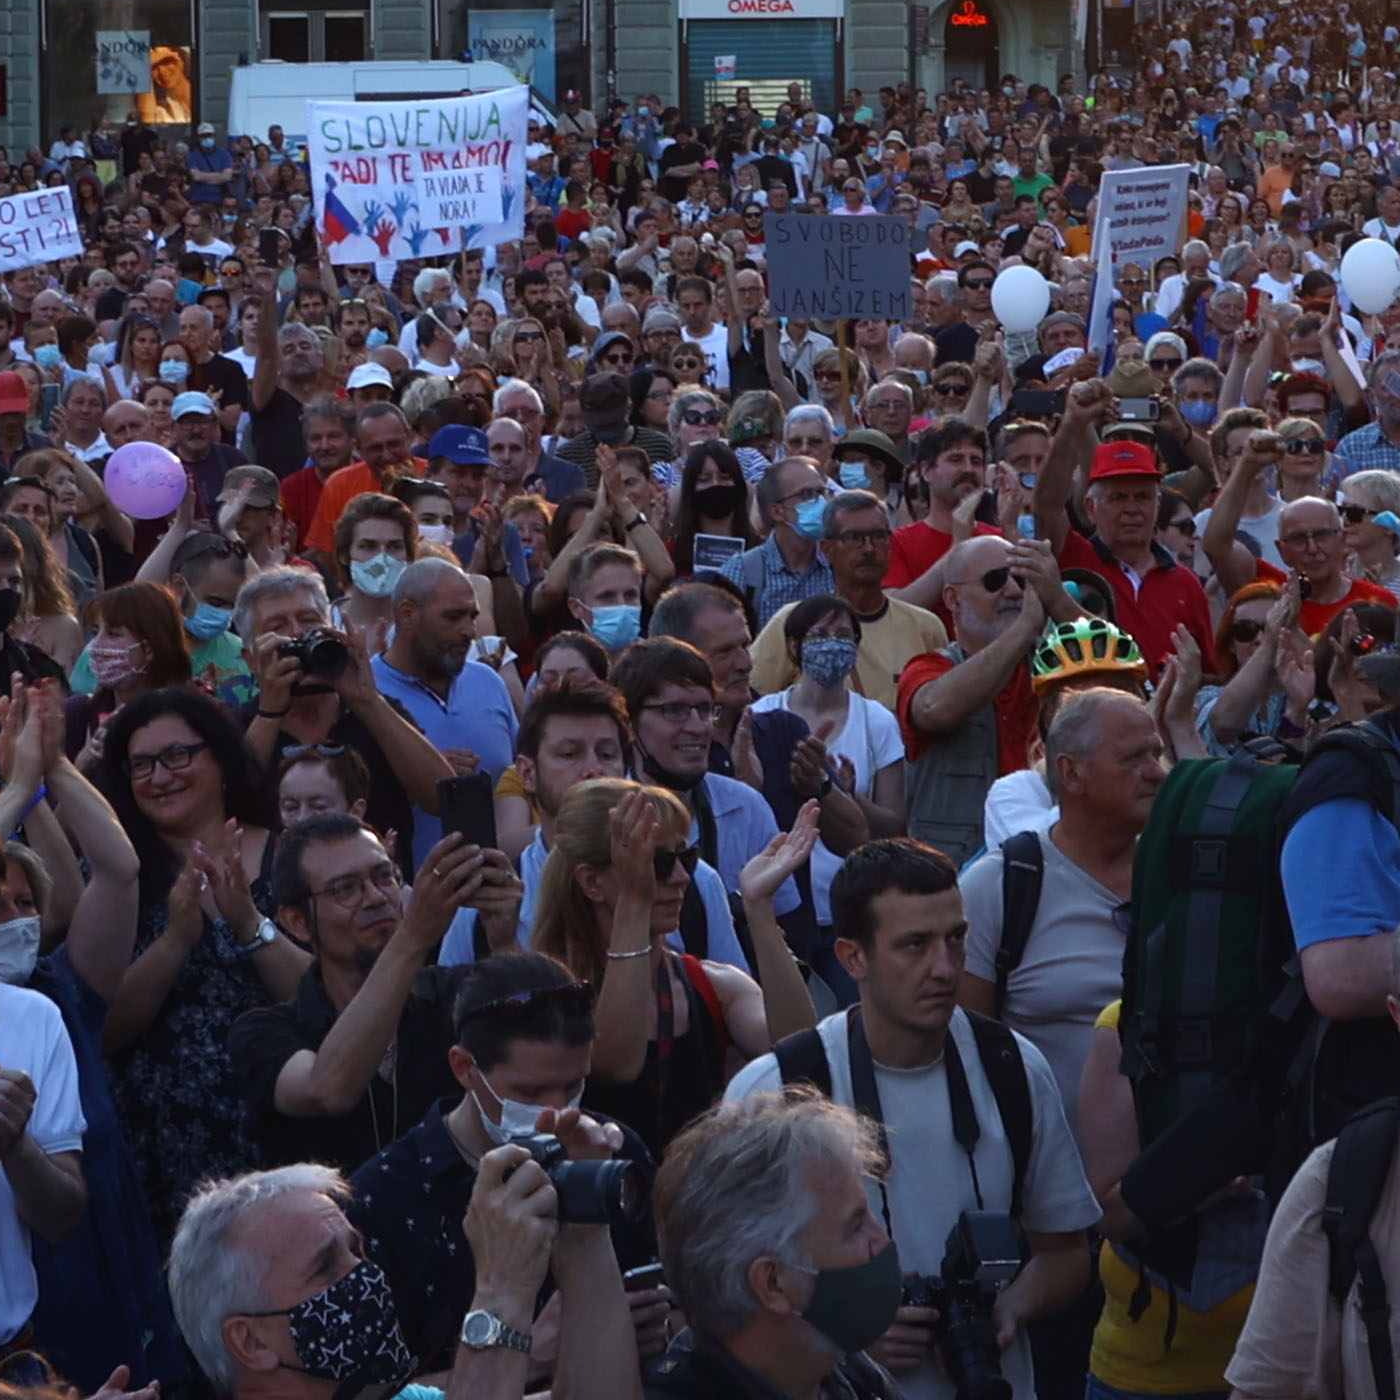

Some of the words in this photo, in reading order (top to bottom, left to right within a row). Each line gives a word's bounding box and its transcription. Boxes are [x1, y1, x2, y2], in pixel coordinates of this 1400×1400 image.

[388, 153, 414, 185] TE
[440, 174, 471, 196] VLADA
[23, 191, 65, 220] LET
[775, 218, 905, 245] SVOBODO
[824, 246, 865, 282] NE
[774, 285, 907, 316] JANŠIZEM
